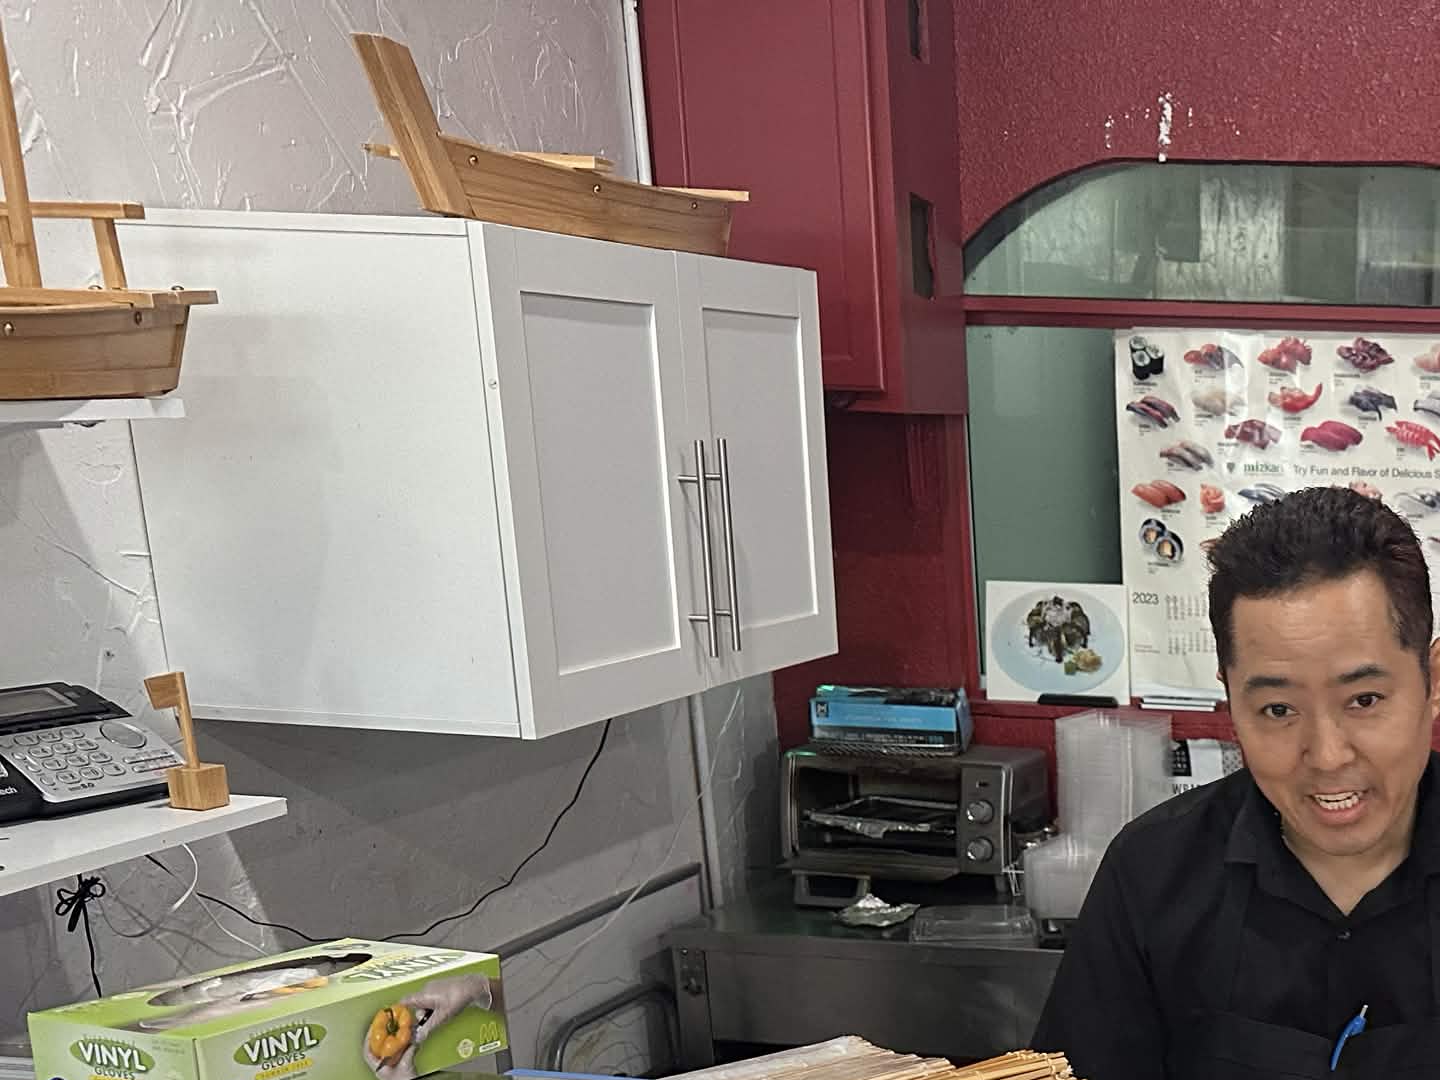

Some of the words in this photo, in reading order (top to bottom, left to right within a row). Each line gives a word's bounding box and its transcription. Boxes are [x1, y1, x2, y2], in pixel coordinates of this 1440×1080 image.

[1293, 464, 1307, 477] Try
[1310, 465, 1329, 475] Fun
[1331, 466, 1350, 476] and
[1352, 467, 1378, 477] Flavor
[1379, 468, 1389, 477] of
[1392, 468, 1433, 479] Delicious
[1132, 592, 1160, 606] 2023
[243, 1026, 318, 1063] VINYL
[78, 1040, 147, 1072] VINYL
[261, 1051, 306, 1071] GLOVES
[94, 1065, 136, 1080] GLOVES
